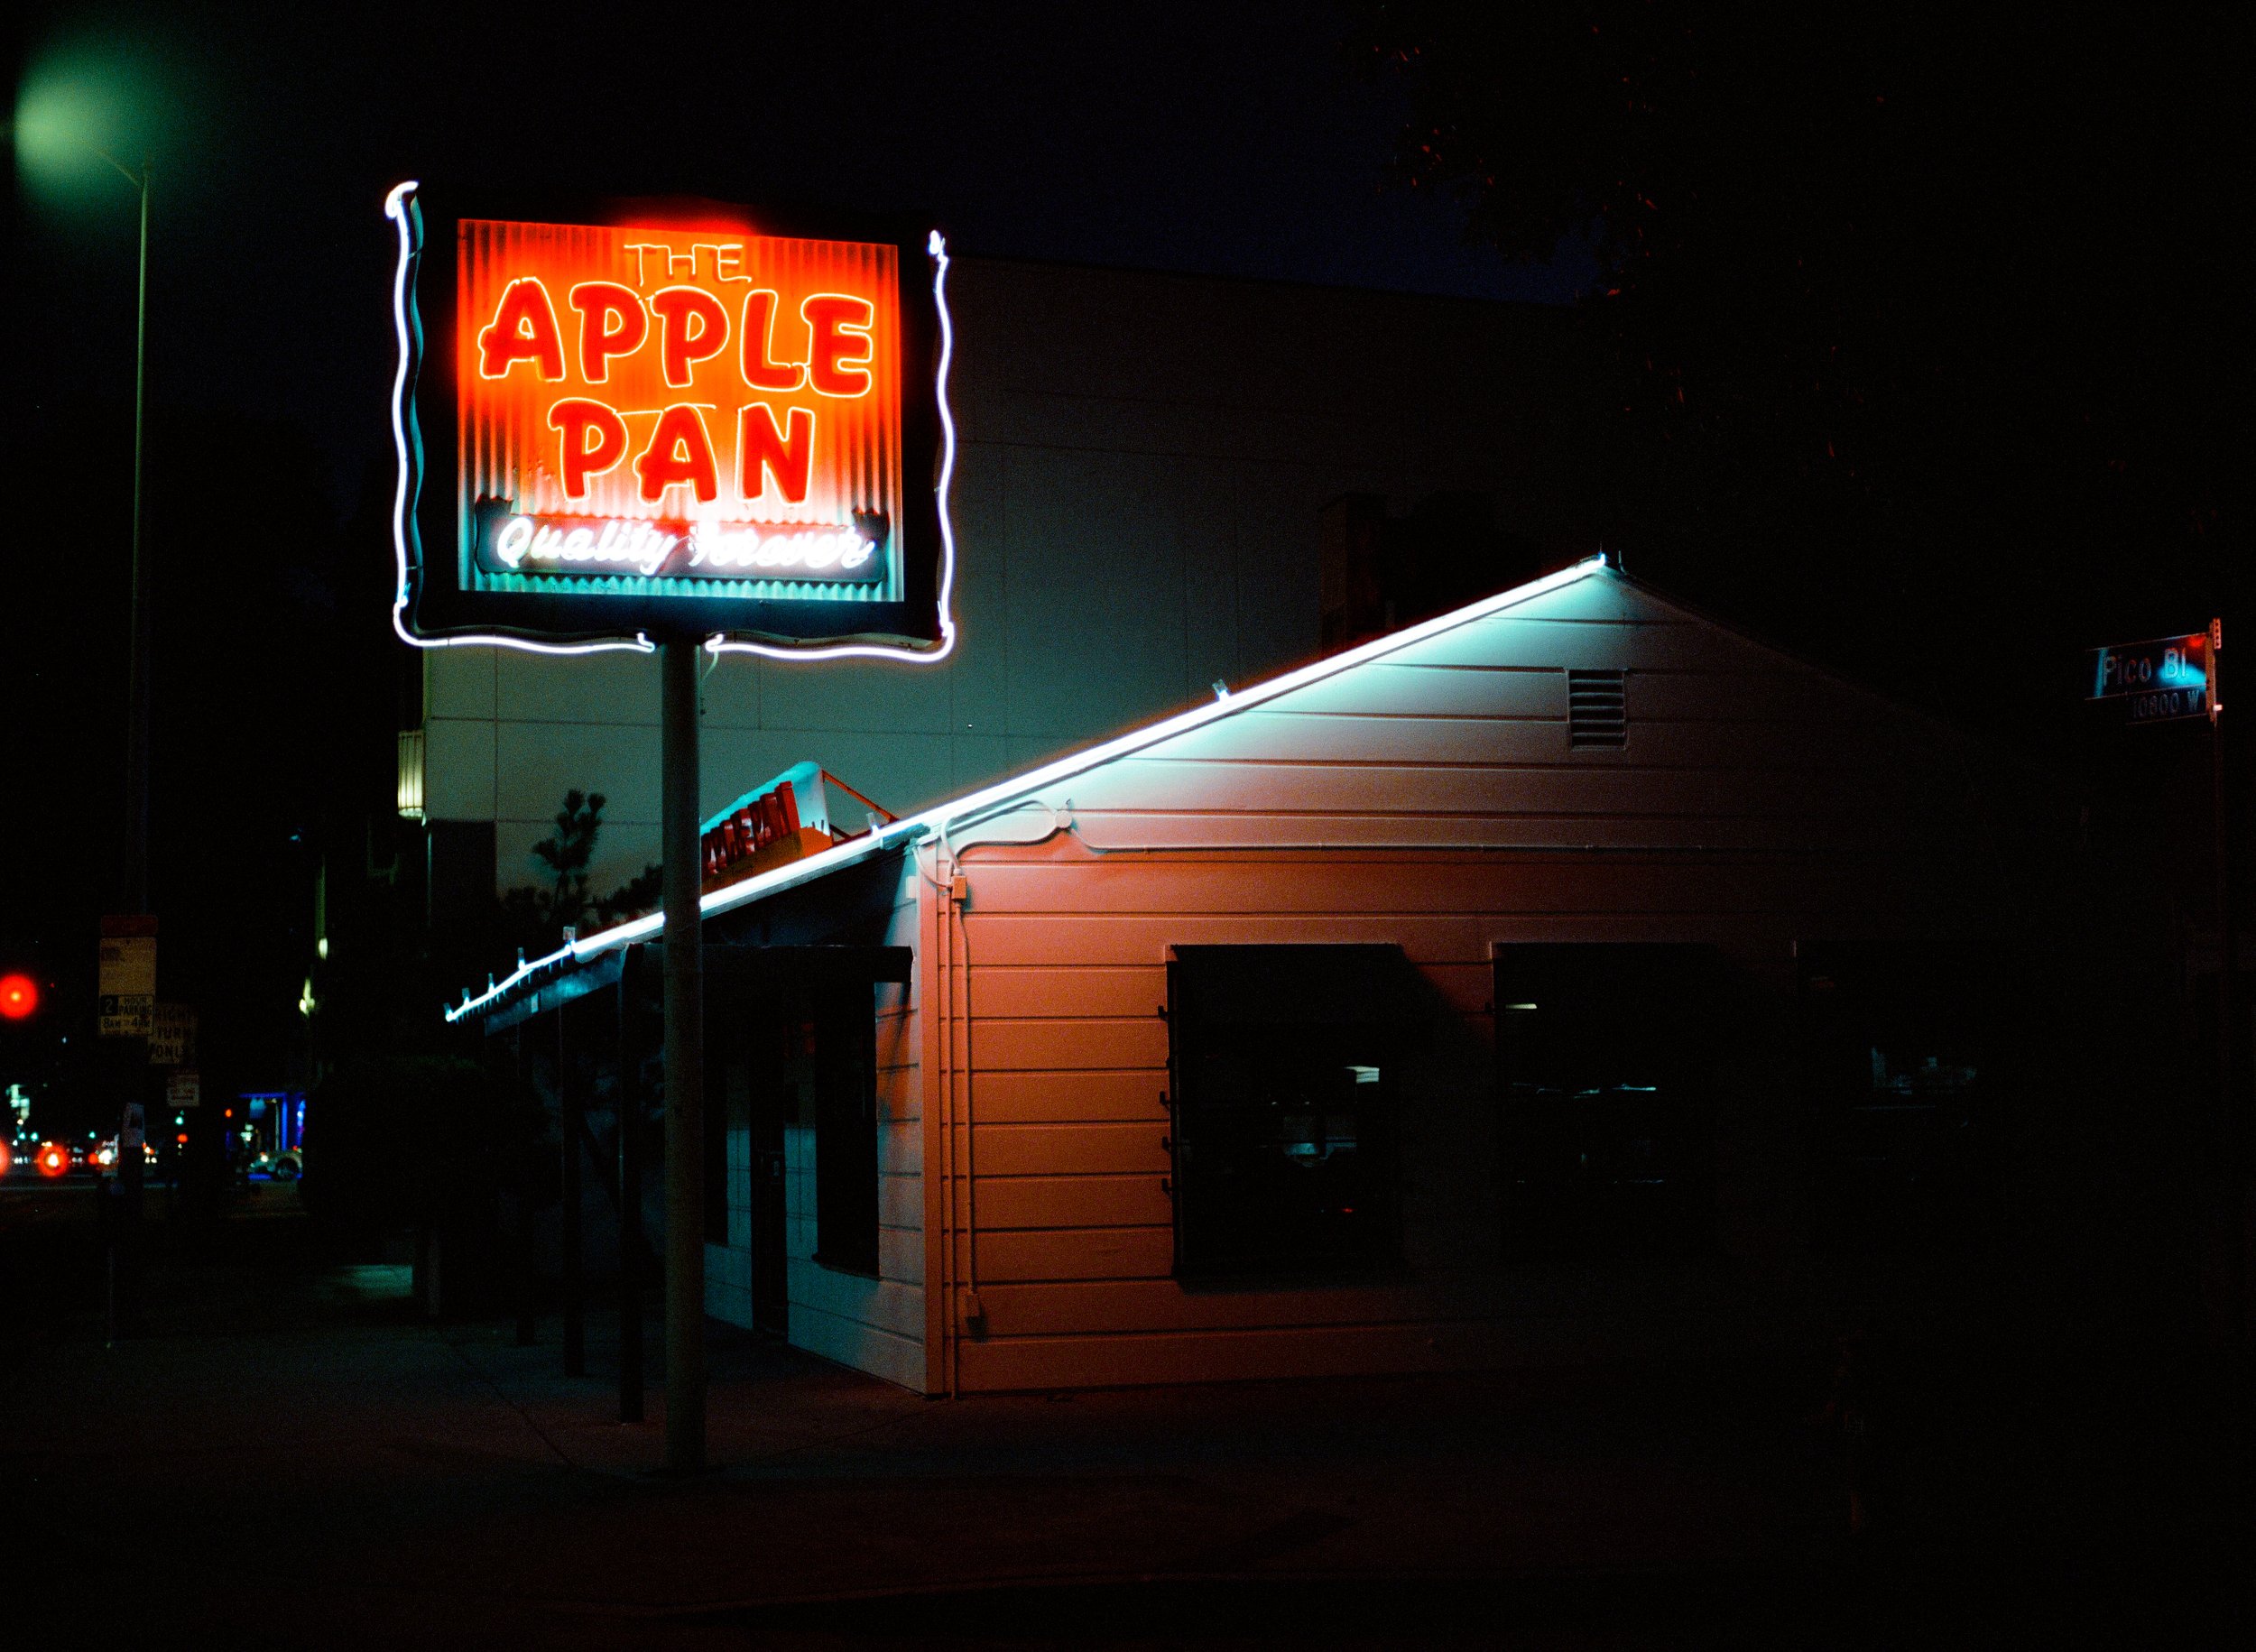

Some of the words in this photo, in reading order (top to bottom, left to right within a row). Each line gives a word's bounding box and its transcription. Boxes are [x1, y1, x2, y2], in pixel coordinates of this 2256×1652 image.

[624, 243, 753, 288] THE
[477, 275, 874, 398] APPLE
[547, 397, 817, 506] PAN
[497, 516, 678, 576] Quality
[688, 517, 876, 569] Forever
[2103, 653, 2152, 687] Pico
[2163, 647, 2187, 679] Bl
[2132, 692, 2180, 719] 10800
[2187, 689, 2200, 713] W
[105, 998, 113, 1014] 2
[157, 1026, 191, 1039] TURN
